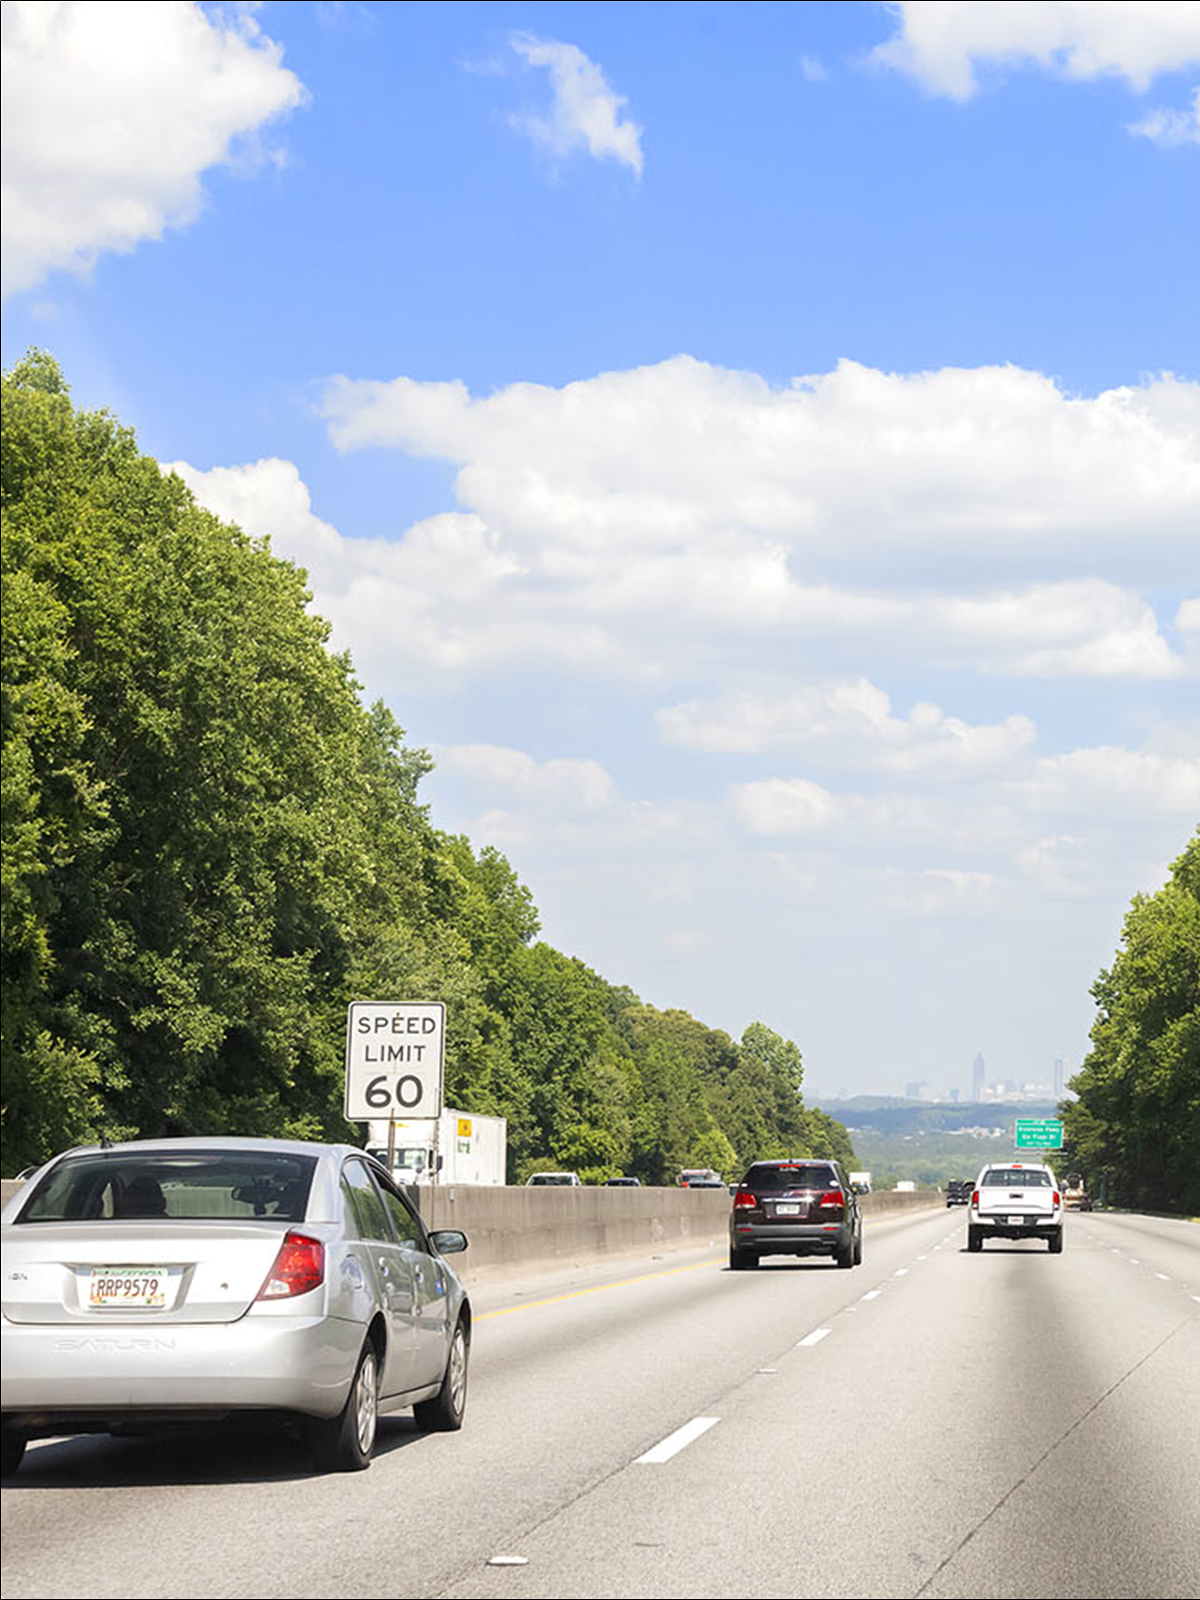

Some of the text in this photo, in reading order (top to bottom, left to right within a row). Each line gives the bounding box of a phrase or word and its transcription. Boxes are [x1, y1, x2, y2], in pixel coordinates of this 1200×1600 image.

[357, 1016, 436, 1034] SPEED
[364, 1044, 426, 1062] LIMIT
[365, 1074, 423, 1109] 60
[97, 1279, 159, 1297] RRP9579
[53, 1338, 177, 1353] SATURN
